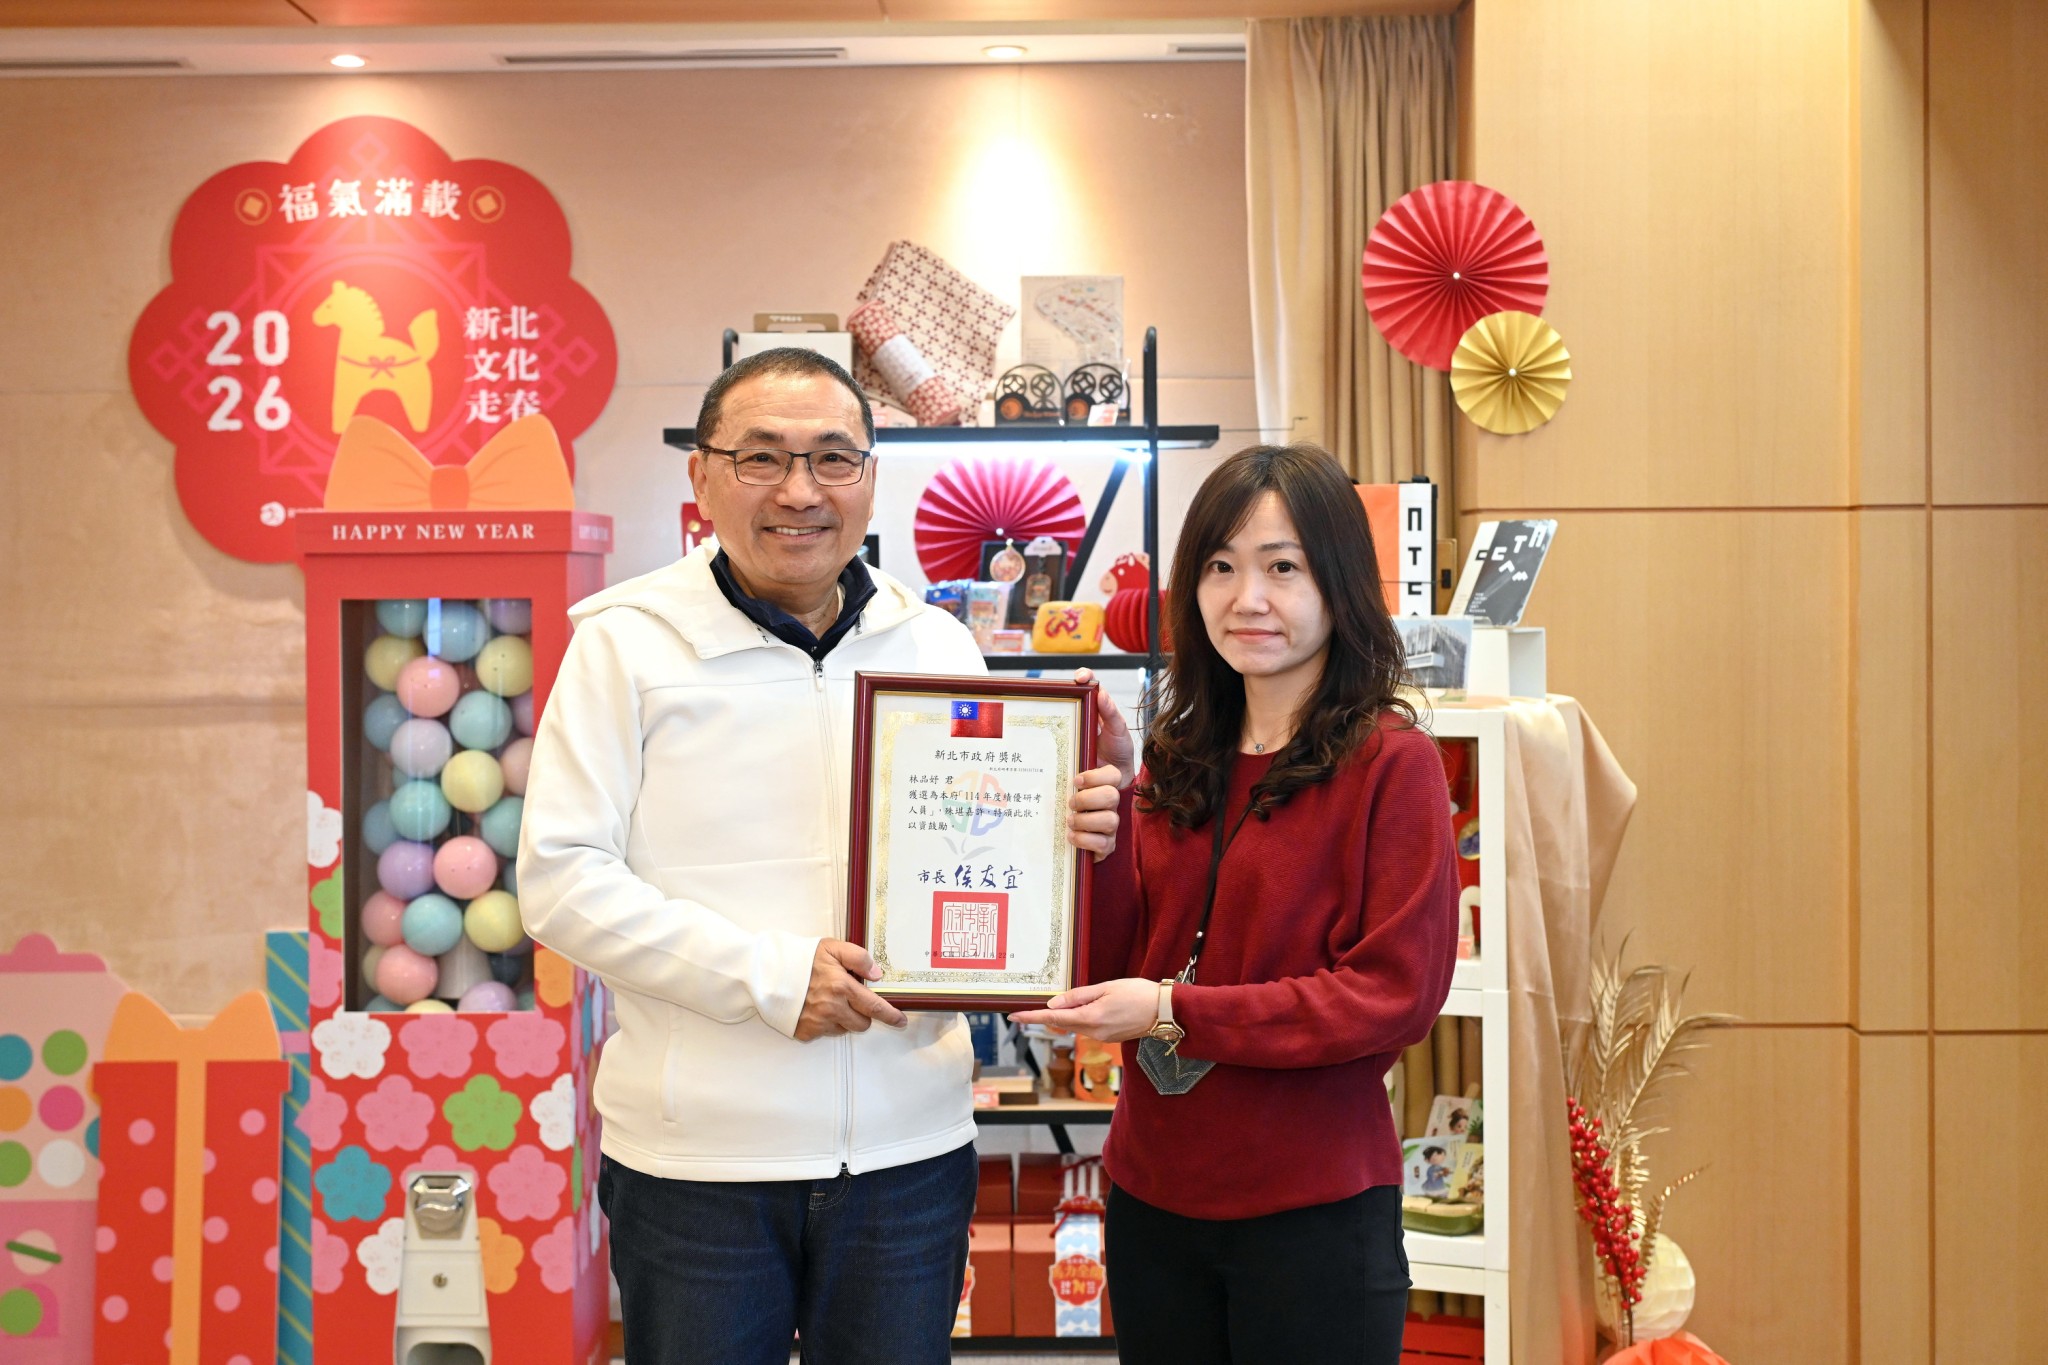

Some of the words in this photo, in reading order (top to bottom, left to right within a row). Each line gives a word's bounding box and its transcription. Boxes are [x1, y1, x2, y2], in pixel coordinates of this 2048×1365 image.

[279, 177, 462, 224] 福氣滿載
[206, 310, 290, 367] 20
[464, 305, 540, 341] 新北
[464, 347, 541, 382] 文化
[207, 376, 292, 432] 26
[332, 524, 407, 540] HAPPY
[416, 524, 466, 540] NEW
[476, 523, 536, 540] YEAR
[934, 749, 1023, 763] 新北市政府獎狀
[917, 869, 946, 884] 市長
[954, 864, 1024, 890] 侯友宜
